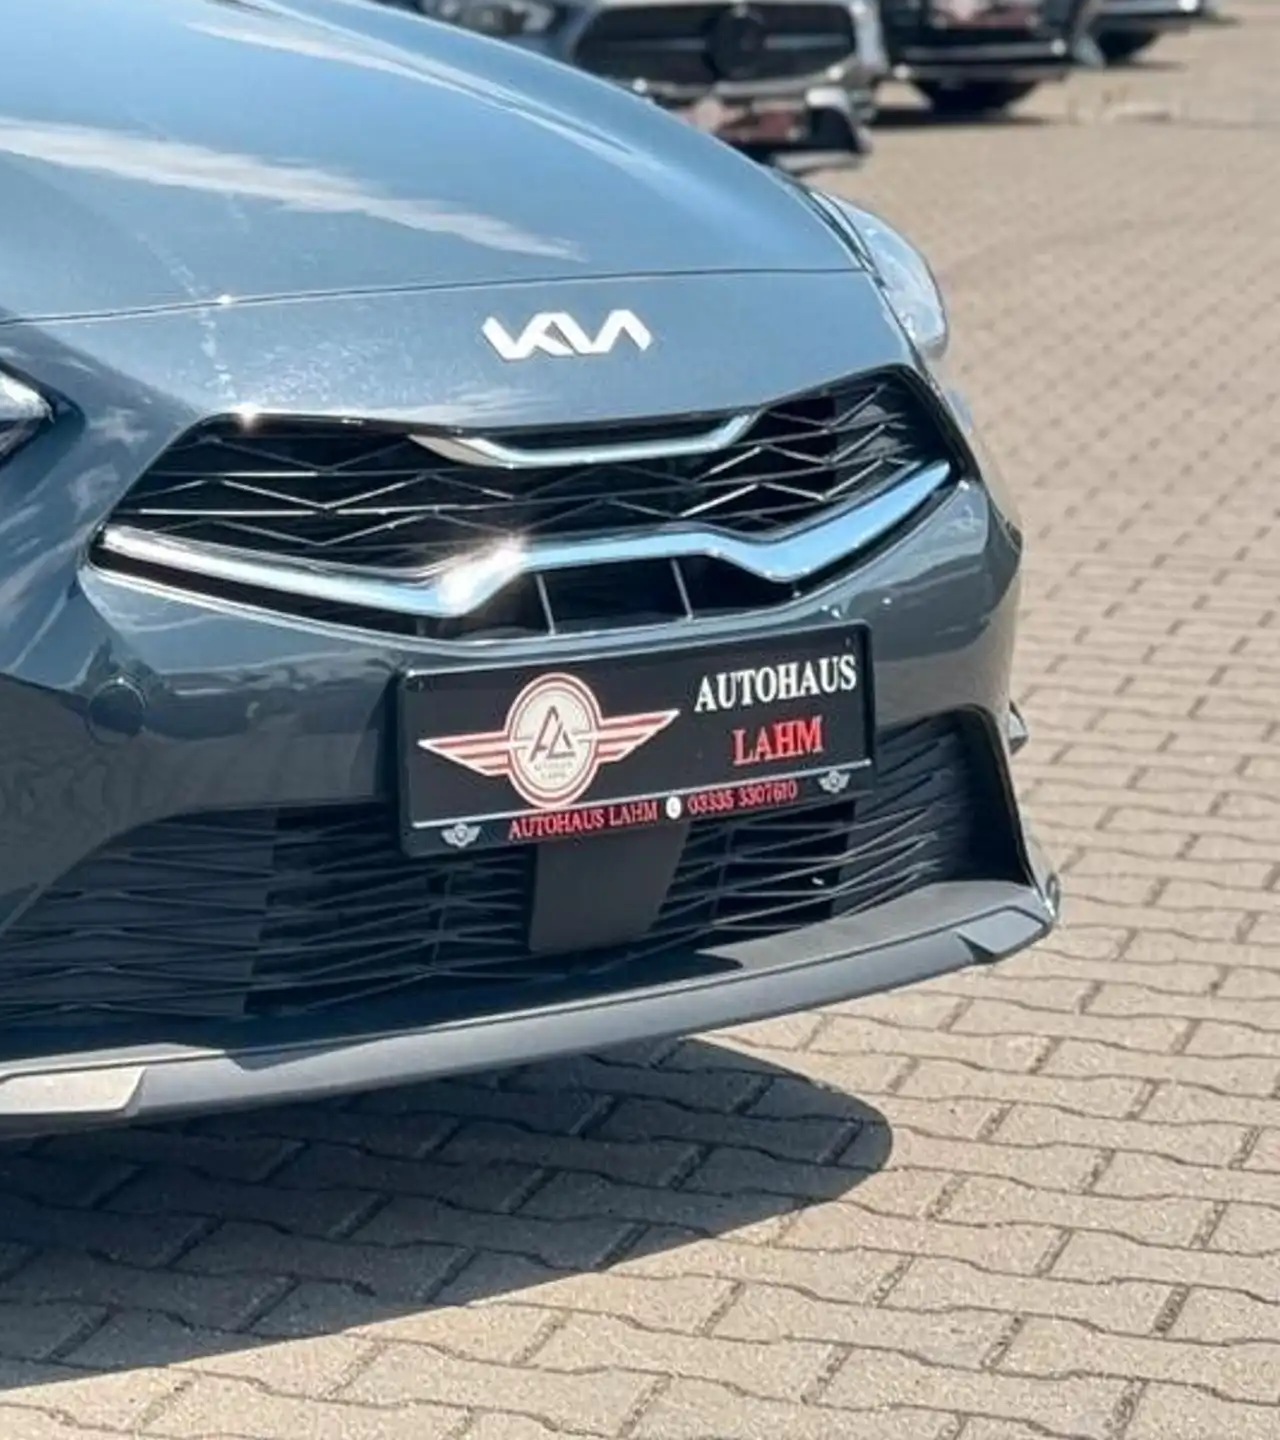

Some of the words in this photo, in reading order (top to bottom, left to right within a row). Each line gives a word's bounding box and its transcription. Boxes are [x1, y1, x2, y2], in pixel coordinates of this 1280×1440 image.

[694, 655, 857, 712] AUTOHAUS
[732, 715, 825, 766] LAHM
[508, 808, 605, 841] AUTOHAUS
[608, 801, 658, 827] LAHM
